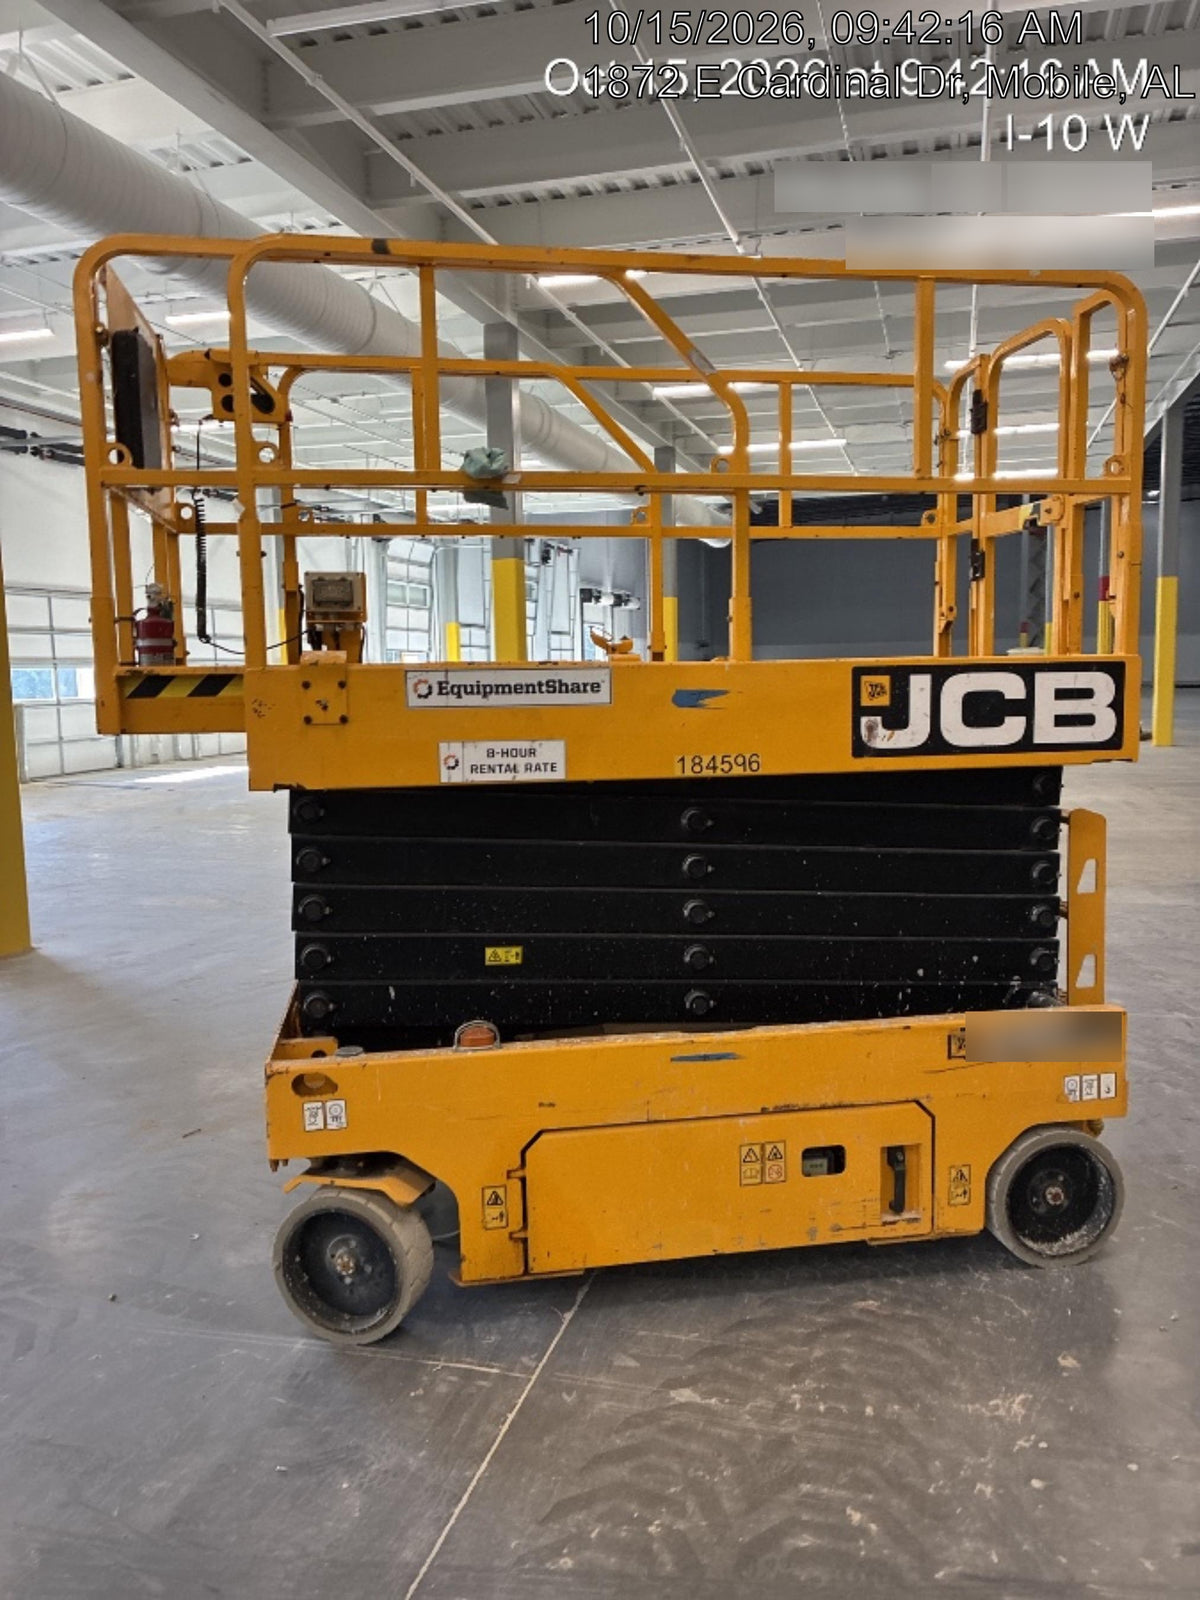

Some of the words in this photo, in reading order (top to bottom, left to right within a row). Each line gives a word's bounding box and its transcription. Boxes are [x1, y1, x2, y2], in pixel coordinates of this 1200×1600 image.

[437, 679, 602, 698] EquipmentShare
[860, 671, 1117, 749] JCB
[486, 747, 537, 759] 8-HOUR
[470, 763, 520, 774] RENTAL
[524, 762, 558, 773] RATE
[677, 753, 760, 774] 184596
